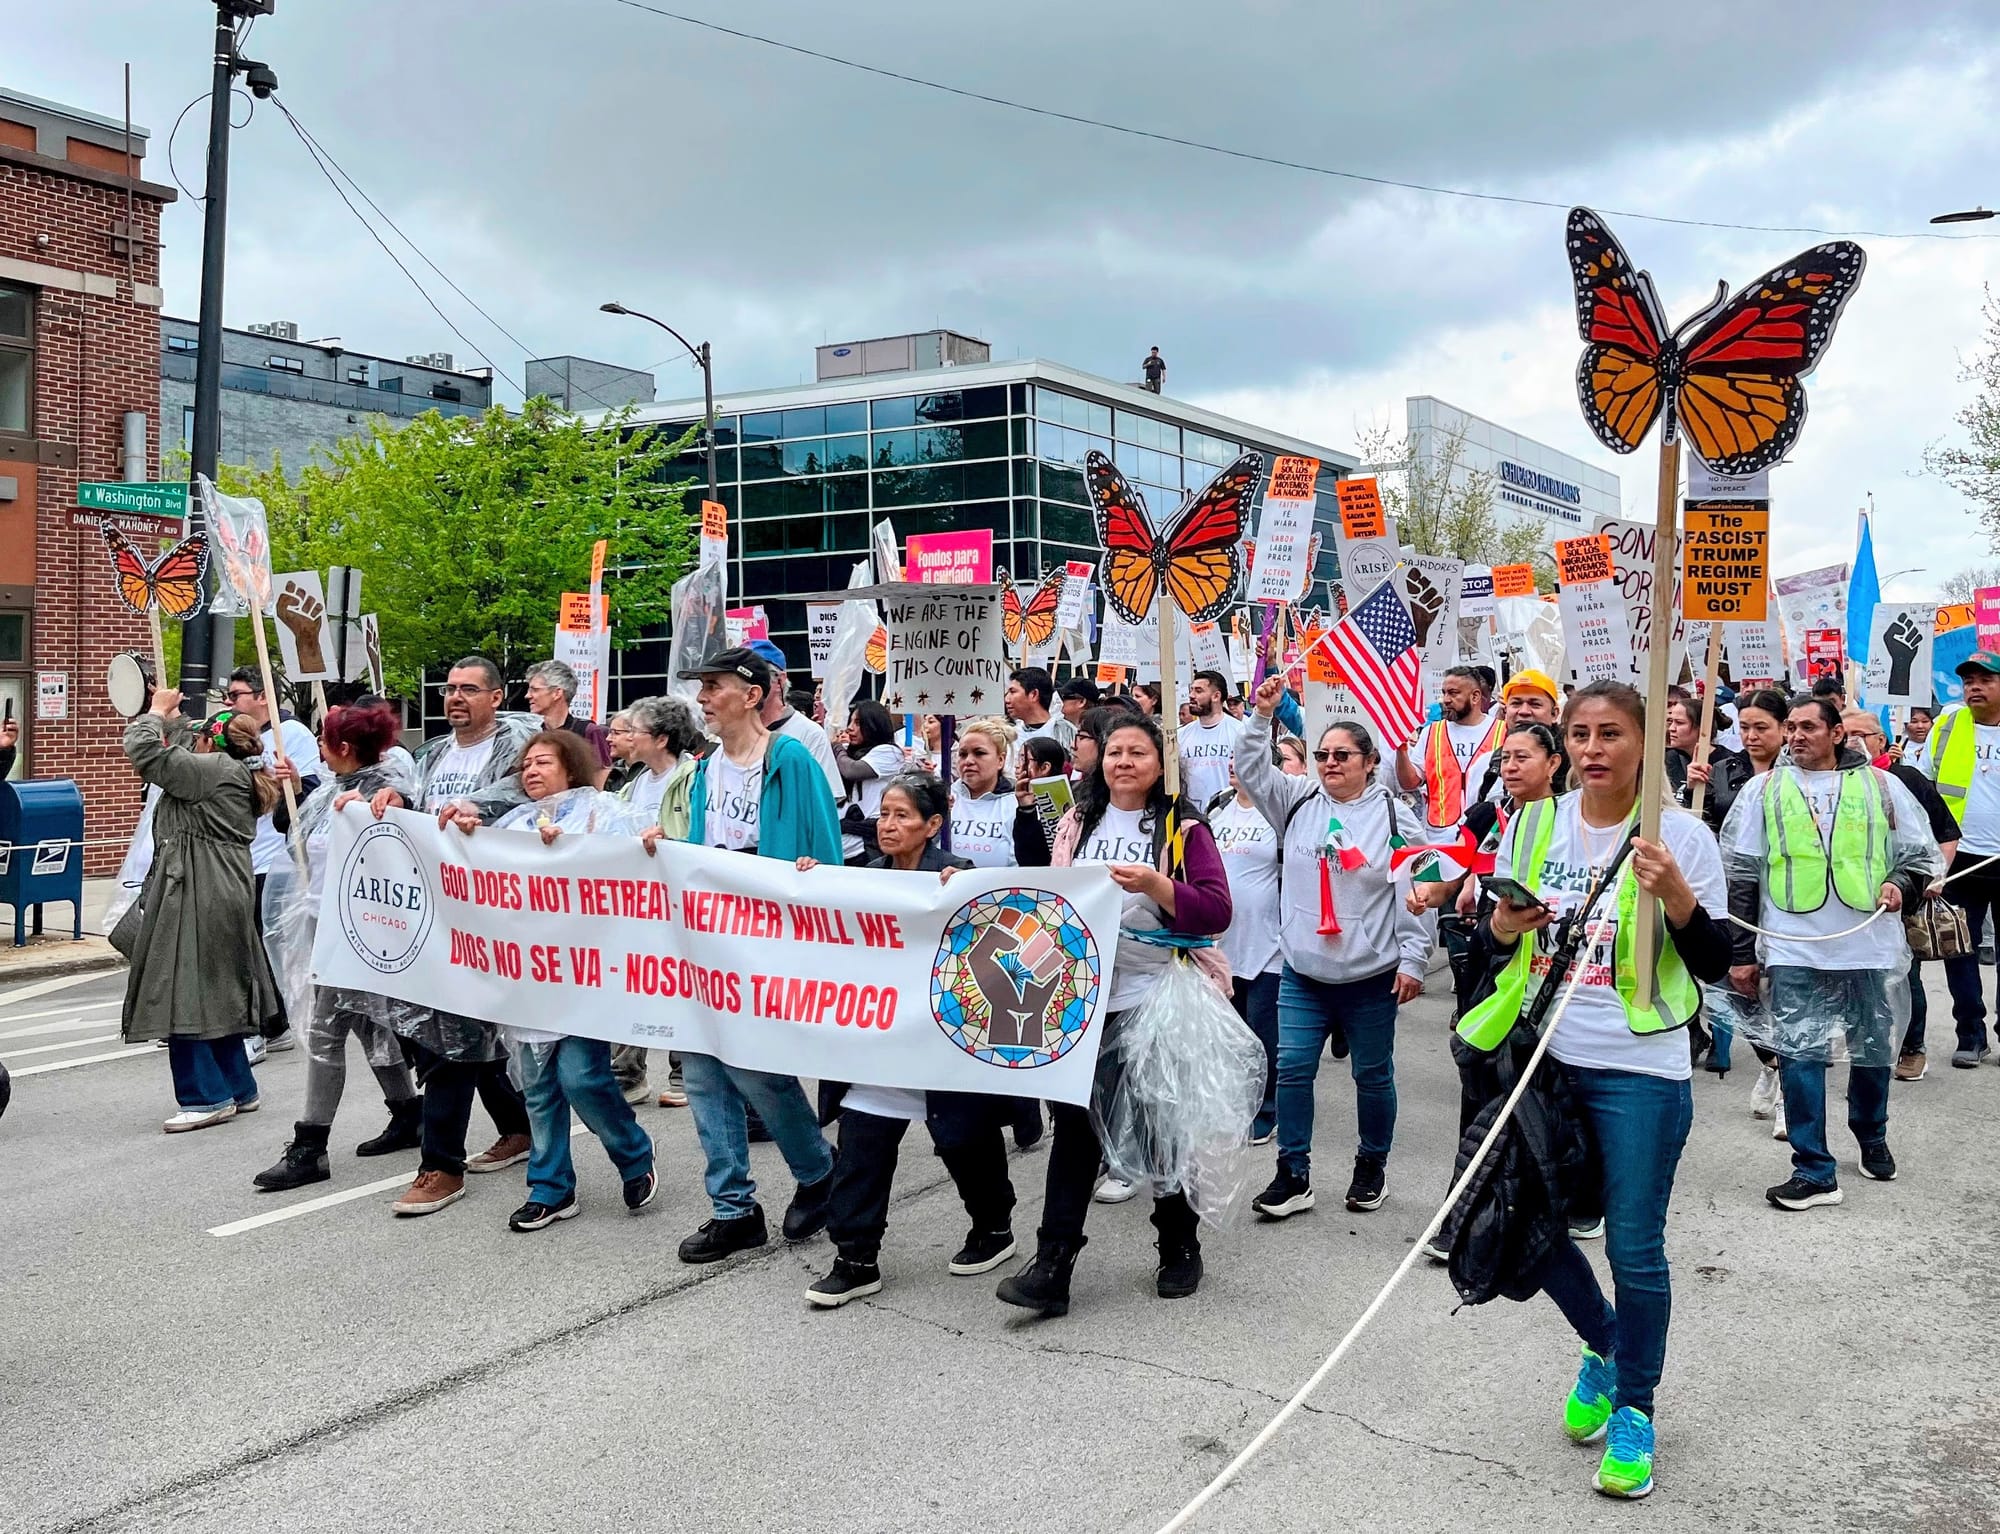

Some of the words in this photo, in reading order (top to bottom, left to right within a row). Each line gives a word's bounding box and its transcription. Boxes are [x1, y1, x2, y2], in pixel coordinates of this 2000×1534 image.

[1274, 474, 1314, 482] MIGRANTES
[1274, 481, 1310, 490] MOVEMOS
[1273, 488, 1282, 496] LA
[84, 489, 91, 499] W
[95, 487, 161, 511] Washington
[165, 499, 182, 509] Blvd
[73, 513, 102, 526] DANIEL
[118, 519, 160, 534] MAHONEY
[164, 526, 178, 535] BLVD
[1273, 519, 1297, 528] WIARA
[1708, 514, 1743, 527] The
[1271, 535, 1294, 543] LABOR
[1685, 531, 1766, 545] FASCIST
[1269, 544, 1293, 552] LABOR
[1564, 541, 1575, 550] DE
[1576, 540, 1593, 548] SOL
[954, 548, 979, 567] para
[1267, 554, 1292, 562] PRACA
[1566, 548, 1581, 558] SOL
[1584, 546, 1601, 554] LOS
[1690, 548, 1759, 561] TRUMP
[1561, 552, 1609, 566] MIGRANTES
[1263, 569, 1291, 577] ACTION
[1354, 562, 1391, 574] ARISE
[1565, 560, 1608, 574] MOVEMOS
[1688, 565, 1762, 579] REGIME
[922, 568, 932, 584] el
[933, 565, 974, 584] cuidado
[1566, 573, 1577, 582] LA
[1261, 577, 1290, 587] ACCIÓN
[1462, 579, 1490, 590] STOP
[1575, 583, 1600, 593] FAITH
[1697, 582, 1752, 596] MUST
[1583, 593, 1593, 601] FÉ
[1576, 602, 1605, 613] WIARA
[1707, 599, 1741, 613] GO!
[890, 603, 917, 624] WE
[921, 603, 948, 622] ARE
[954, 604, 989, 622] THE
[812, 626, 823, 634] NO
[825, 625, 835, 634] SE
[1579, 618, 1607, 629] LABOR
[1581, 627, 1609, 638] LABOR
[890, 628, 952, 652] ENGINE
[1583, 637, 1612, 648] PRACA
[1584, 653, 1616, 663] ACTION
[892, 657, 929, 684] THIS
[934, 656, 1001, 683] COUNTRY
[1586, 662, 1618, 673] ACCIÓN
[1323, 670, 1337, 679] eth
[1326, 683, 1352, 691] FAIT
[1325, 704, 1357, 714] WIARA
[1184, 743, 1229, 758] ARISE
[438, 783, 472, 796] LUCH
[951, 819, 1004, 840] RISE
[1214, 826, 1265, 842] RISE
[1543, 860, 1565, 875] TU
[352, 875, 422, 912] ARISE
[440, 860, 469, 902] GOD
[471, 868, 523, 912] DOES
[527, 874, 571, 914] NOT
[681, 888, 784, 940] NEITHER
[787, 903, 856, 946] WILL
[855, 910, 905, 950] WE
[362, 912, 408, 931] CHICAGO
[348, 930, 365, 955] FAITH
[371, 958, 393, 970] LABOR
[399, 944, 419, 968] ACTION
[449, 927, 491, 974] DIOS
[492, 938, 523, 981] NO
[530, 943, 563, 984] SE
[569, 946, 601, 988] VA
[625, 951, 743, 1015] NOSOTROS
[750, 974, 899, 1031] TAMPOCO
